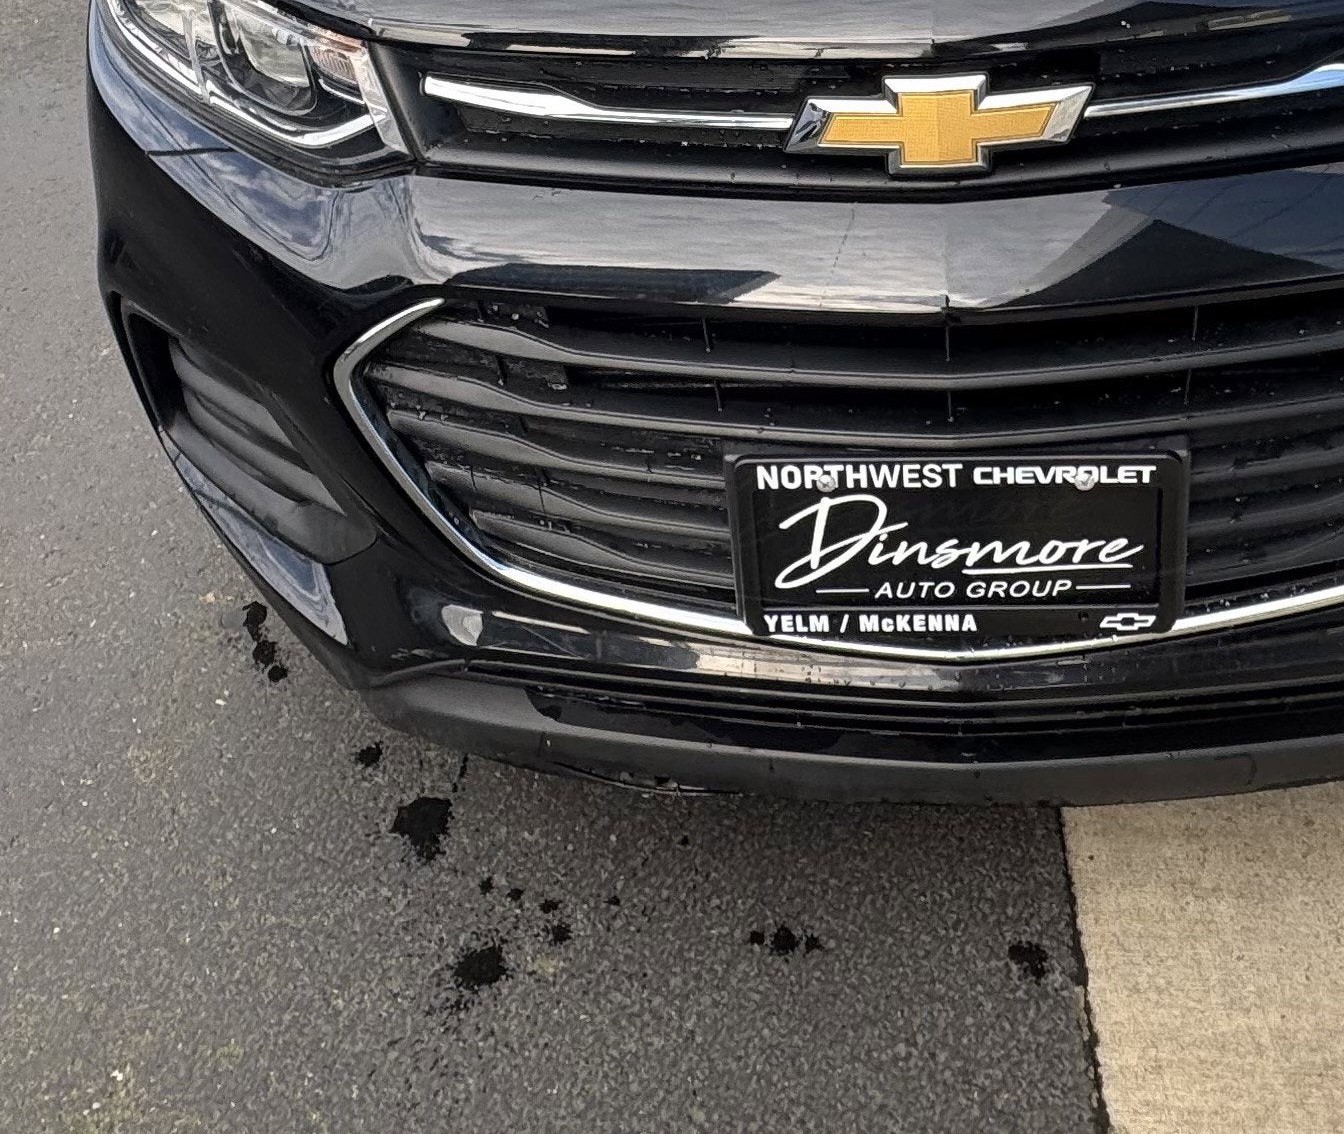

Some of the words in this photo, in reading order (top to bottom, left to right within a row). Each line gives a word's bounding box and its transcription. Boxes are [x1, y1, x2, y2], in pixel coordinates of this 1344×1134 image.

[757, 463, 963, 490] NORTHWEST
[973, 465, 1156, 485] CHEVROLET
[775, 494, 1144, 589] Dinsmore
[874, 581, 955, 599] AUTO
[965, 579, 1072, 599] GROUP
[763, 614, 830, 633] YELM
[859, 614, 977, 632] McKENNA
